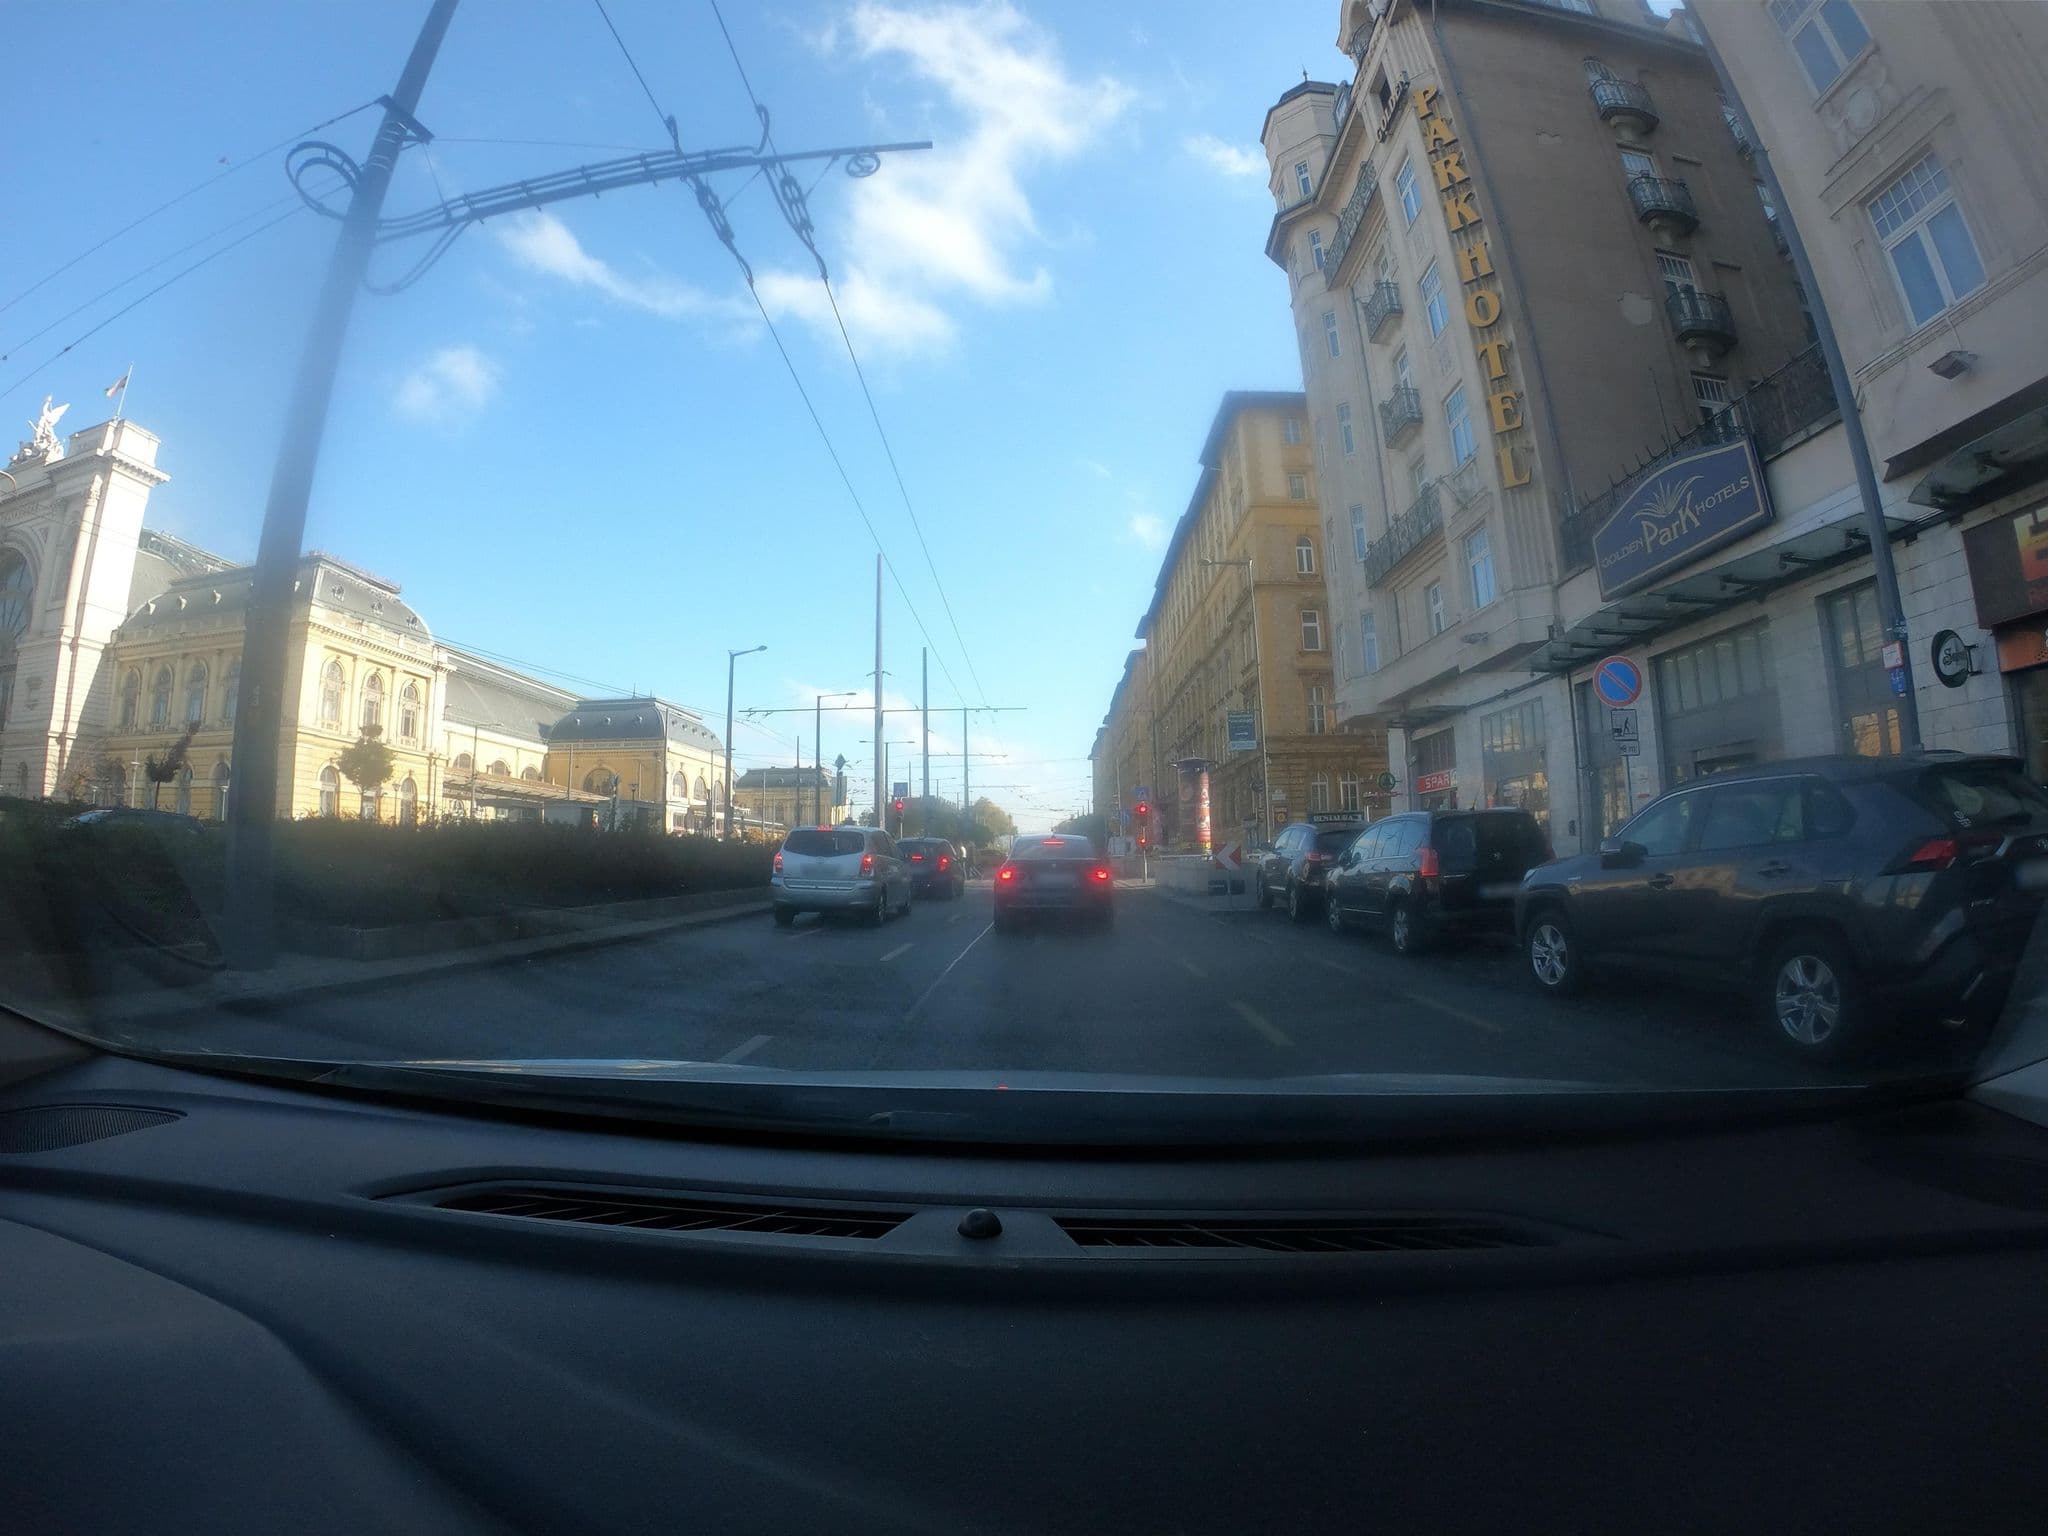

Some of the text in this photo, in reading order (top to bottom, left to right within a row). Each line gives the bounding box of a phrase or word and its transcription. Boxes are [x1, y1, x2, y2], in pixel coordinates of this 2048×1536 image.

[1601, 537, 1644, 569] GOLDEN
[1694, 475, 1751, 516] HOTELS
[1424, 773, 1450, 789] SPAR
